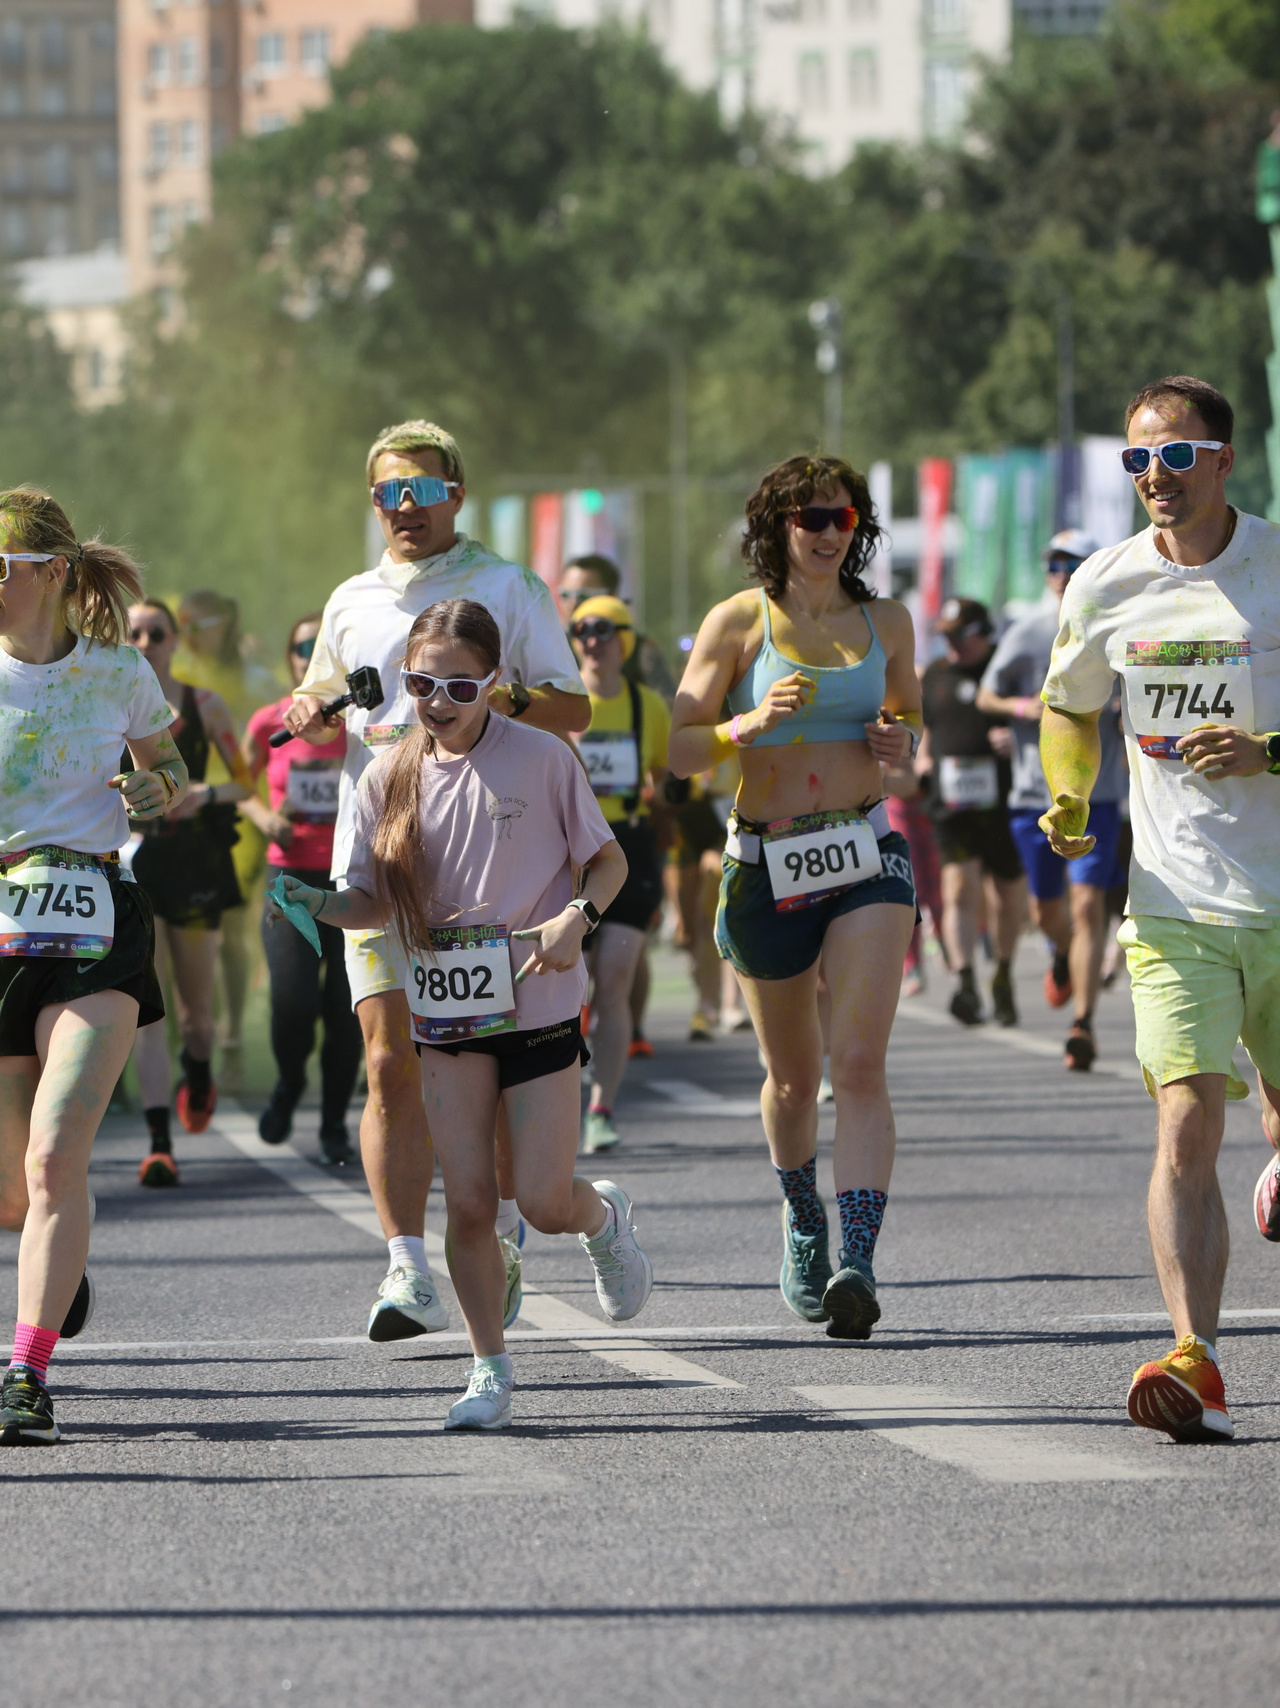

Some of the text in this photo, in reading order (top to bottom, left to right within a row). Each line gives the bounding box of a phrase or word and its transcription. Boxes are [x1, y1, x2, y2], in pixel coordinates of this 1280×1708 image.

[1194, 657, 1248, 666] 2026
[1144, 683, 1235, 719] 7744
[784, 839, 860, 882] 9801
[880, 853, 912, 887] KE
[8, 882, 96, 918] 7745
[452, 938, 505, 951] 2026
[414, 965, 495, 1002] 9802
